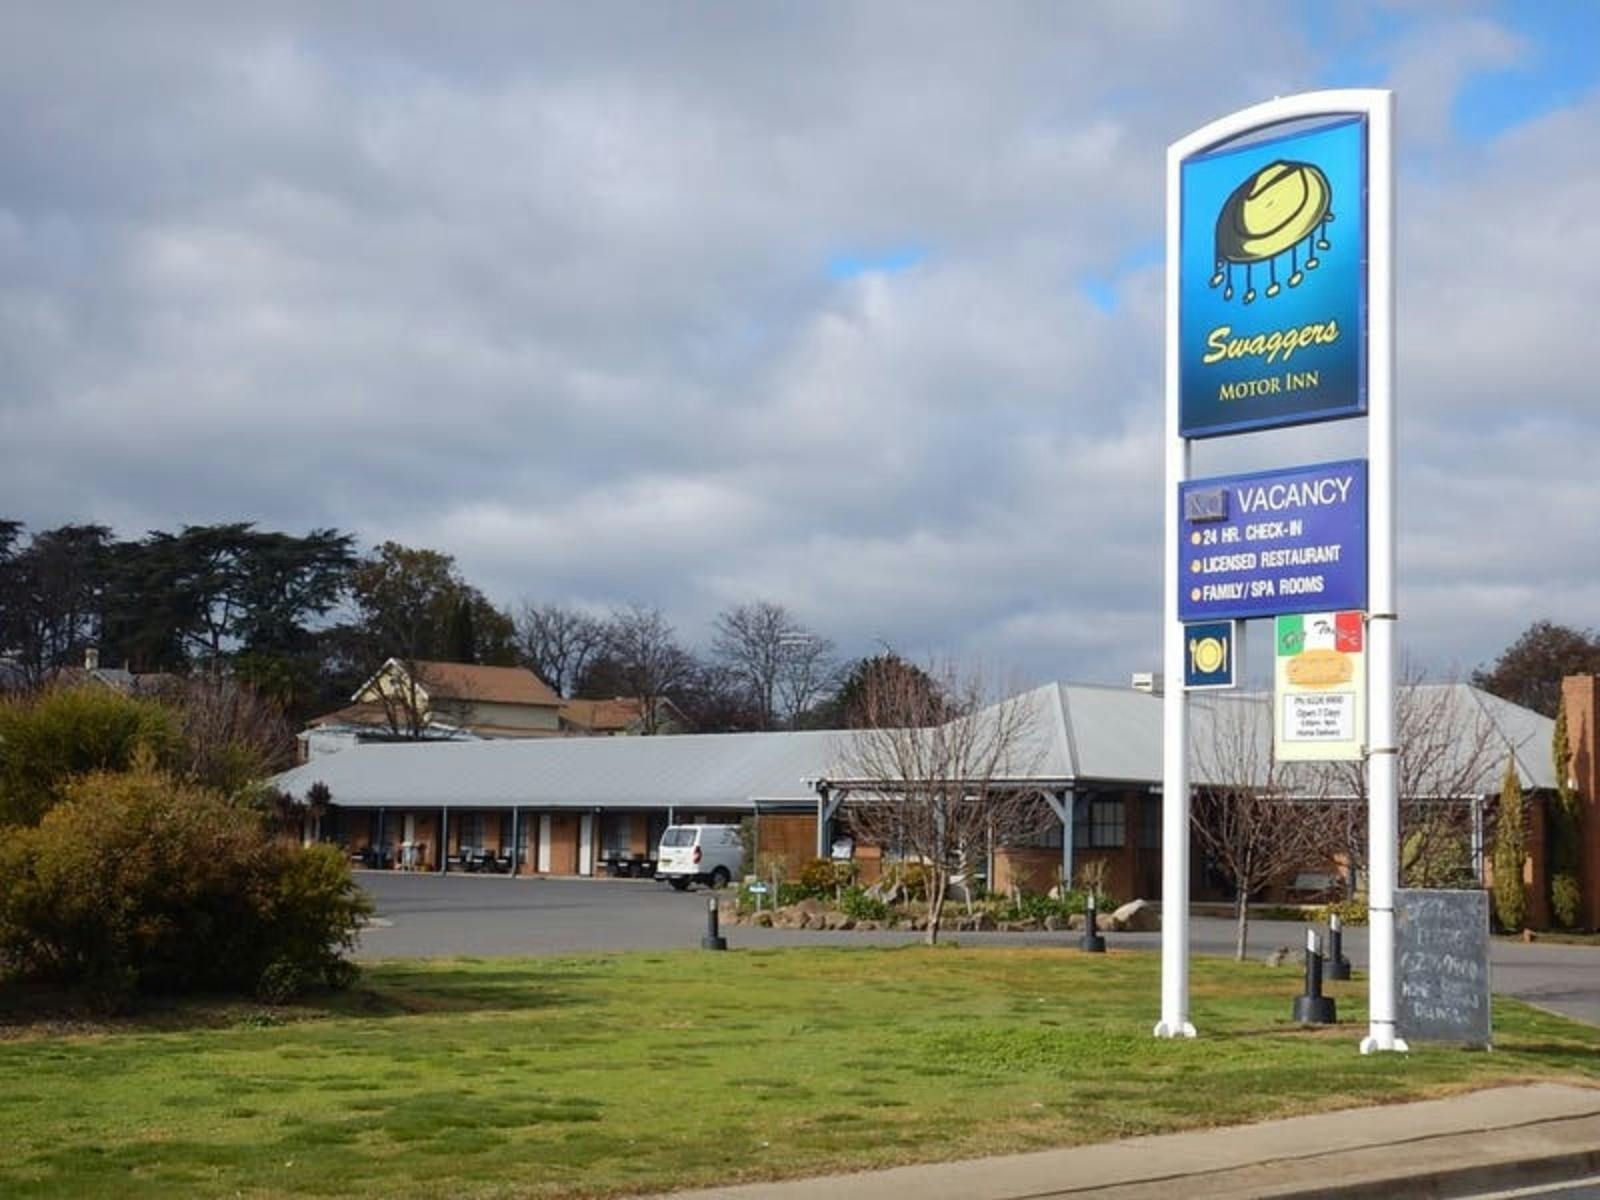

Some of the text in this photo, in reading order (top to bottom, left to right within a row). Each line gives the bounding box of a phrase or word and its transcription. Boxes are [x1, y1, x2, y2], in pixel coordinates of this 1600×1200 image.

[1203, 319, 1339, 363] Swaggers
[1219, 370, 1319, 400] MOTOR INN
[1237, 476, 1352, 513] VACANCY
[1203, 528, 1217, 545] 24
[1245, 520, 1303, 541] CHECK-IN
[1203, 545, 1341, 573] LICENSED RESTAURANT
[1279, 576, 1325, 596] ROOMS
